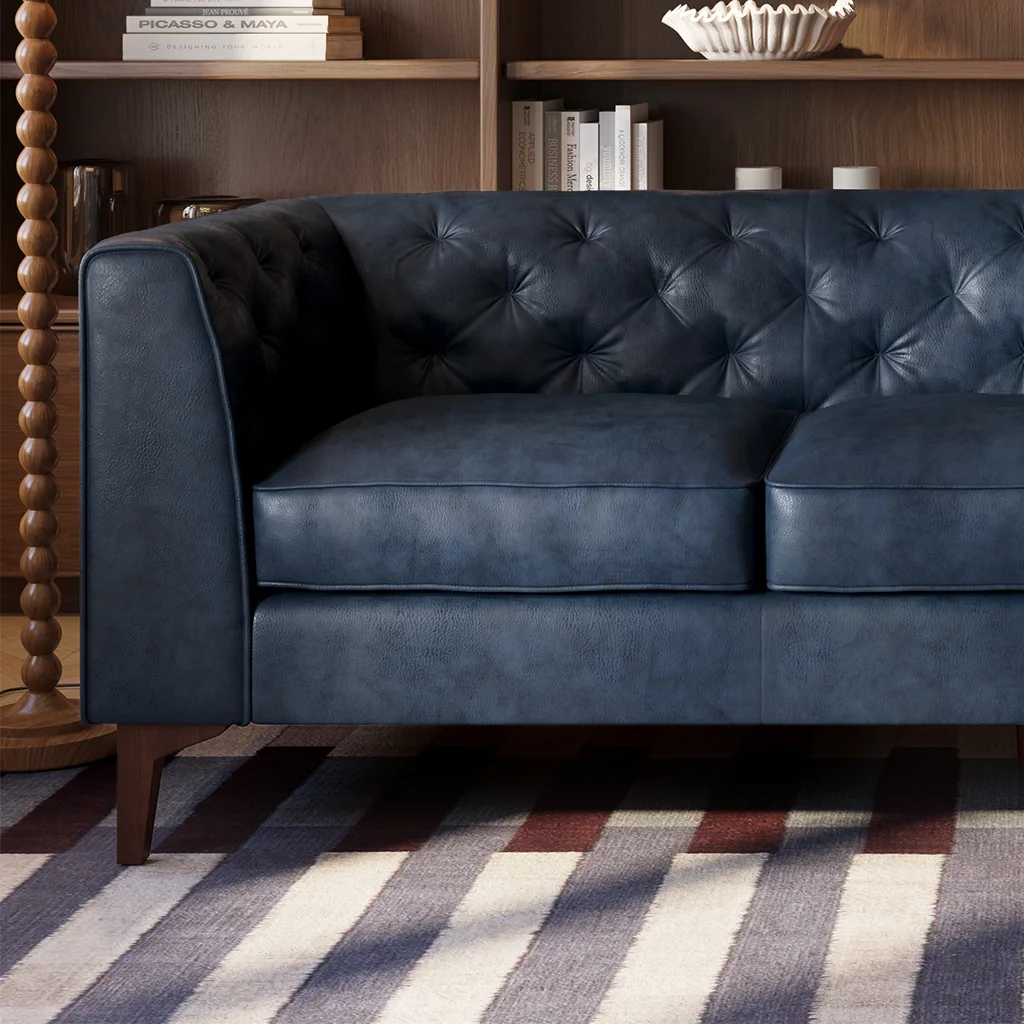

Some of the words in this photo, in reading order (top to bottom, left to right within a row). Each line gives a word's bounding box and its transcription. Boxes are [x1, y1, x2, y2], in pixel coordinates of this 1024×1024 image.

[139, 20, 218, 28] PICASSO
[223, 20, 236, 28] &
[241, 20, 288, 28] MAYA
[202, 8, 219, 16] JEAN
[220, 7, 249, 16] PROUVÉ
[518, 132, 526, 191] ECONOMETRICS
[548, 138, 558, 182] BUSINESS
[567, 144, 576, 172] Fashion
[618, 134, 626, 165] CLOCKWORK
